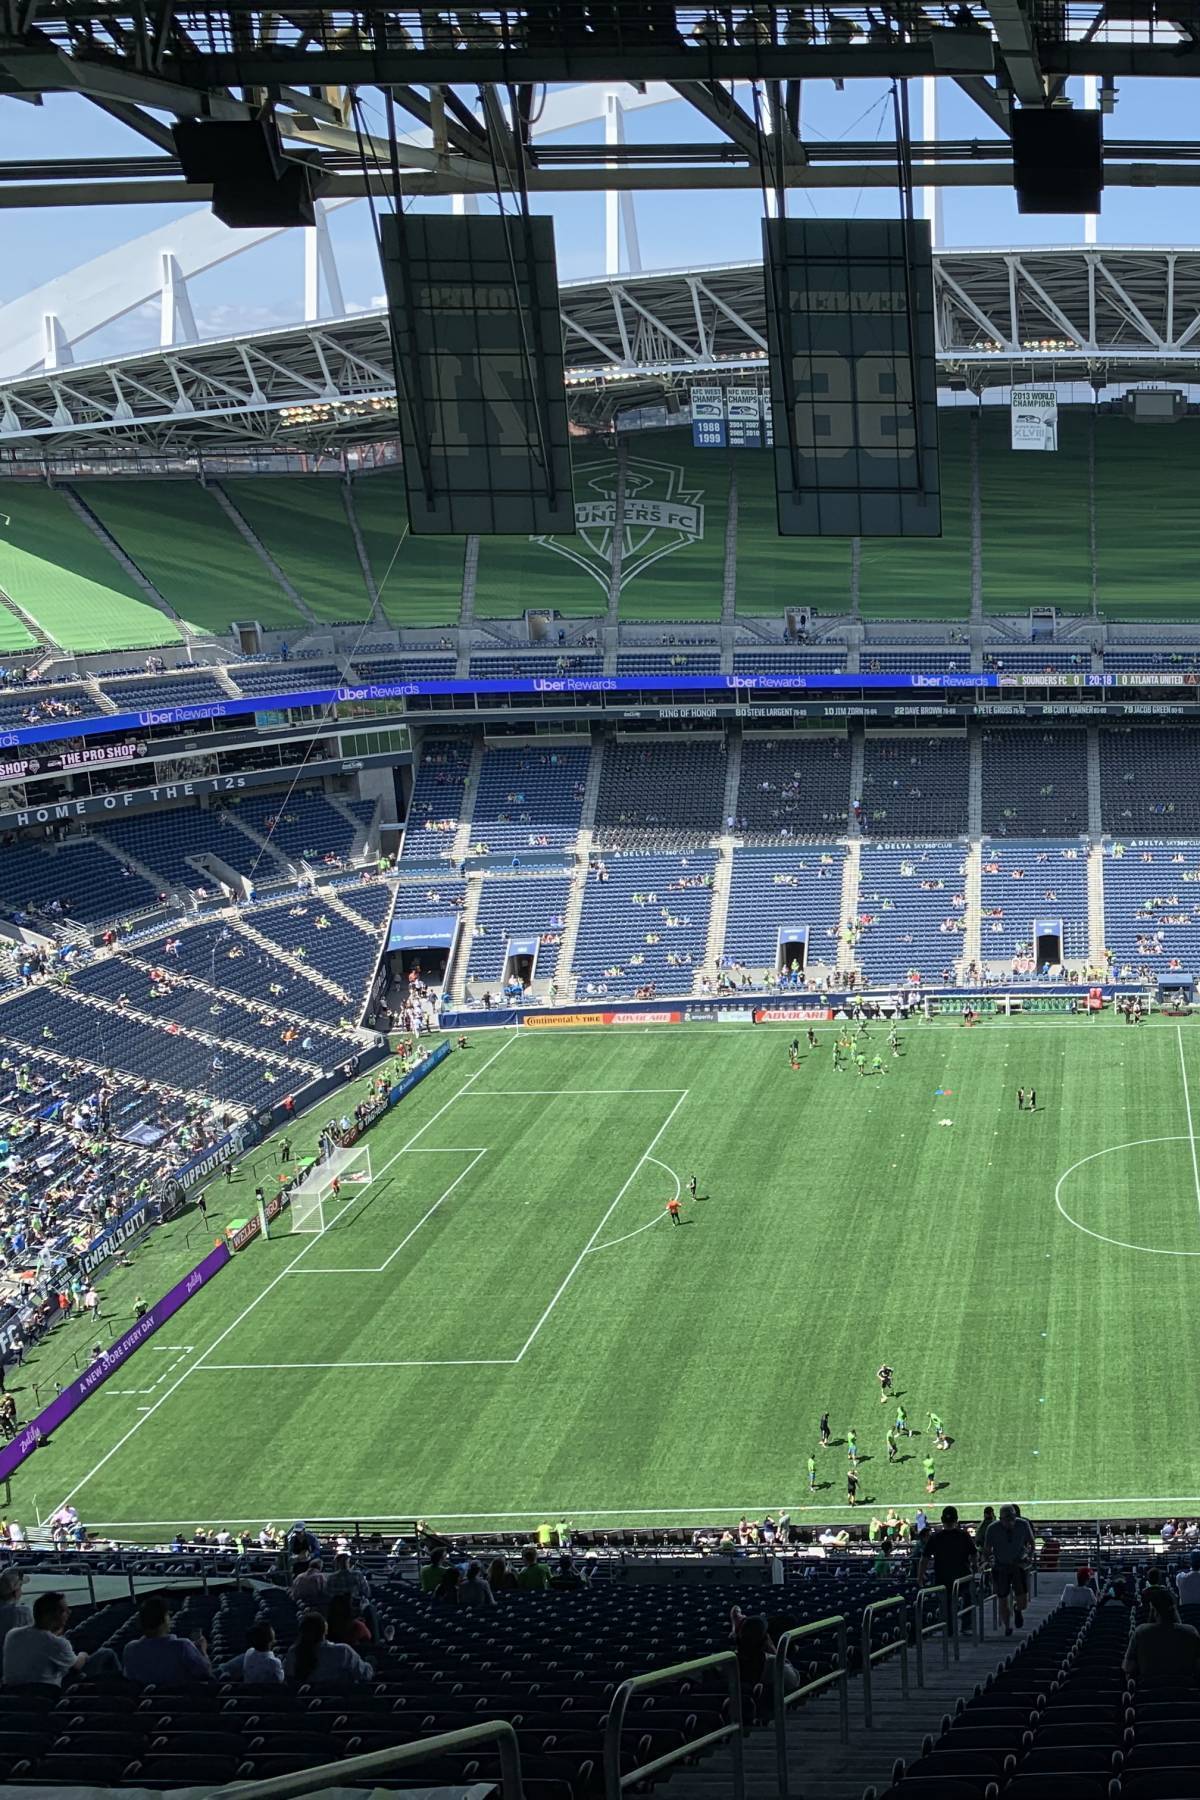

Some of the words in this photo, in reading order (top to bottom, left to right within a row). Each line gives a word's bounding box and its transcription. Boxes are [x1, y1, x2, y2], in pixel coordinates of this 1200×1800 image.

[728, 396, 758, 404] CHAMPS
[1013, 392, 1031, 400] 2013
[1031, 392, 1055, 400] WORLD
[1013, 400, 1055, 408] CHAMPIONS
[698, 423, 720, 432] 1988
[699, 434, 721, 443] 1999
[668, 513, 693, 528] FC
[533, 679, 565, 691] Uber
[567, 678, 617, 690] Rewards
[726, 676, 757, 687] Uber
[759, 676, 807, 687] Rewards
[911, 675, 941, 686] Uber
[943, 675, 988, 686] Rewards
[1022, 675, 1057, 685] SOUNDERS
[1058, 675, 1068, 685] FC
[1073, 675, 1080, 685] 0
[1089, 675, 1112, 685] 20:18
[1122, 675, 1128, 685] 0
[1130, 675, 1159, 685] ATLANTA
[1159, 675, 1184, 685] UNITED
[338, 687, 368, 701] Uber
[370, 683, 420, 698] Rewards
[139, 710, 173, 726] Uber
[174, 703, 226, 722] Rewards
[659, 709, 679, 718] RING
[680, 709, 690, 718] OF
[691, 709, 717, 718] HONOR
[747, 708, 765, 717] STEVE
[766, 708, 793, 717] LARGENT
[894, 707, 905, 715] 22
[60, 752, 82, 765] THE
[83, 749, 106, 762] PRO
[106, 744, 137, 759] SHOP
[17, 801, 86, 826] HOME
[104, 793, 134, 809] OF
[152, 783, 194, 801] THE
[212, 778, 246, 791] 12s
[622, 850, 651, 858] DELTA
[526, 1015, 574, 1026] Continental
[766, 1011, 826, 1020] ADVOCARE
[178, 1140, 238, 1191] SUPPORTERS
[233, 1220, 257, 1249] WELLS
[83, 1231, 126, 1274] EMERALD
[124, 1209, 147, 1242] CITY
[79, 1382, 87, 1394] A
[86, 1366, 103, 1388] NEW
[101, 1347, 124, 1371] STORE
[122, 1328, 143, 1351] EVERY
[141, 1315, 156, 1333] DAY
